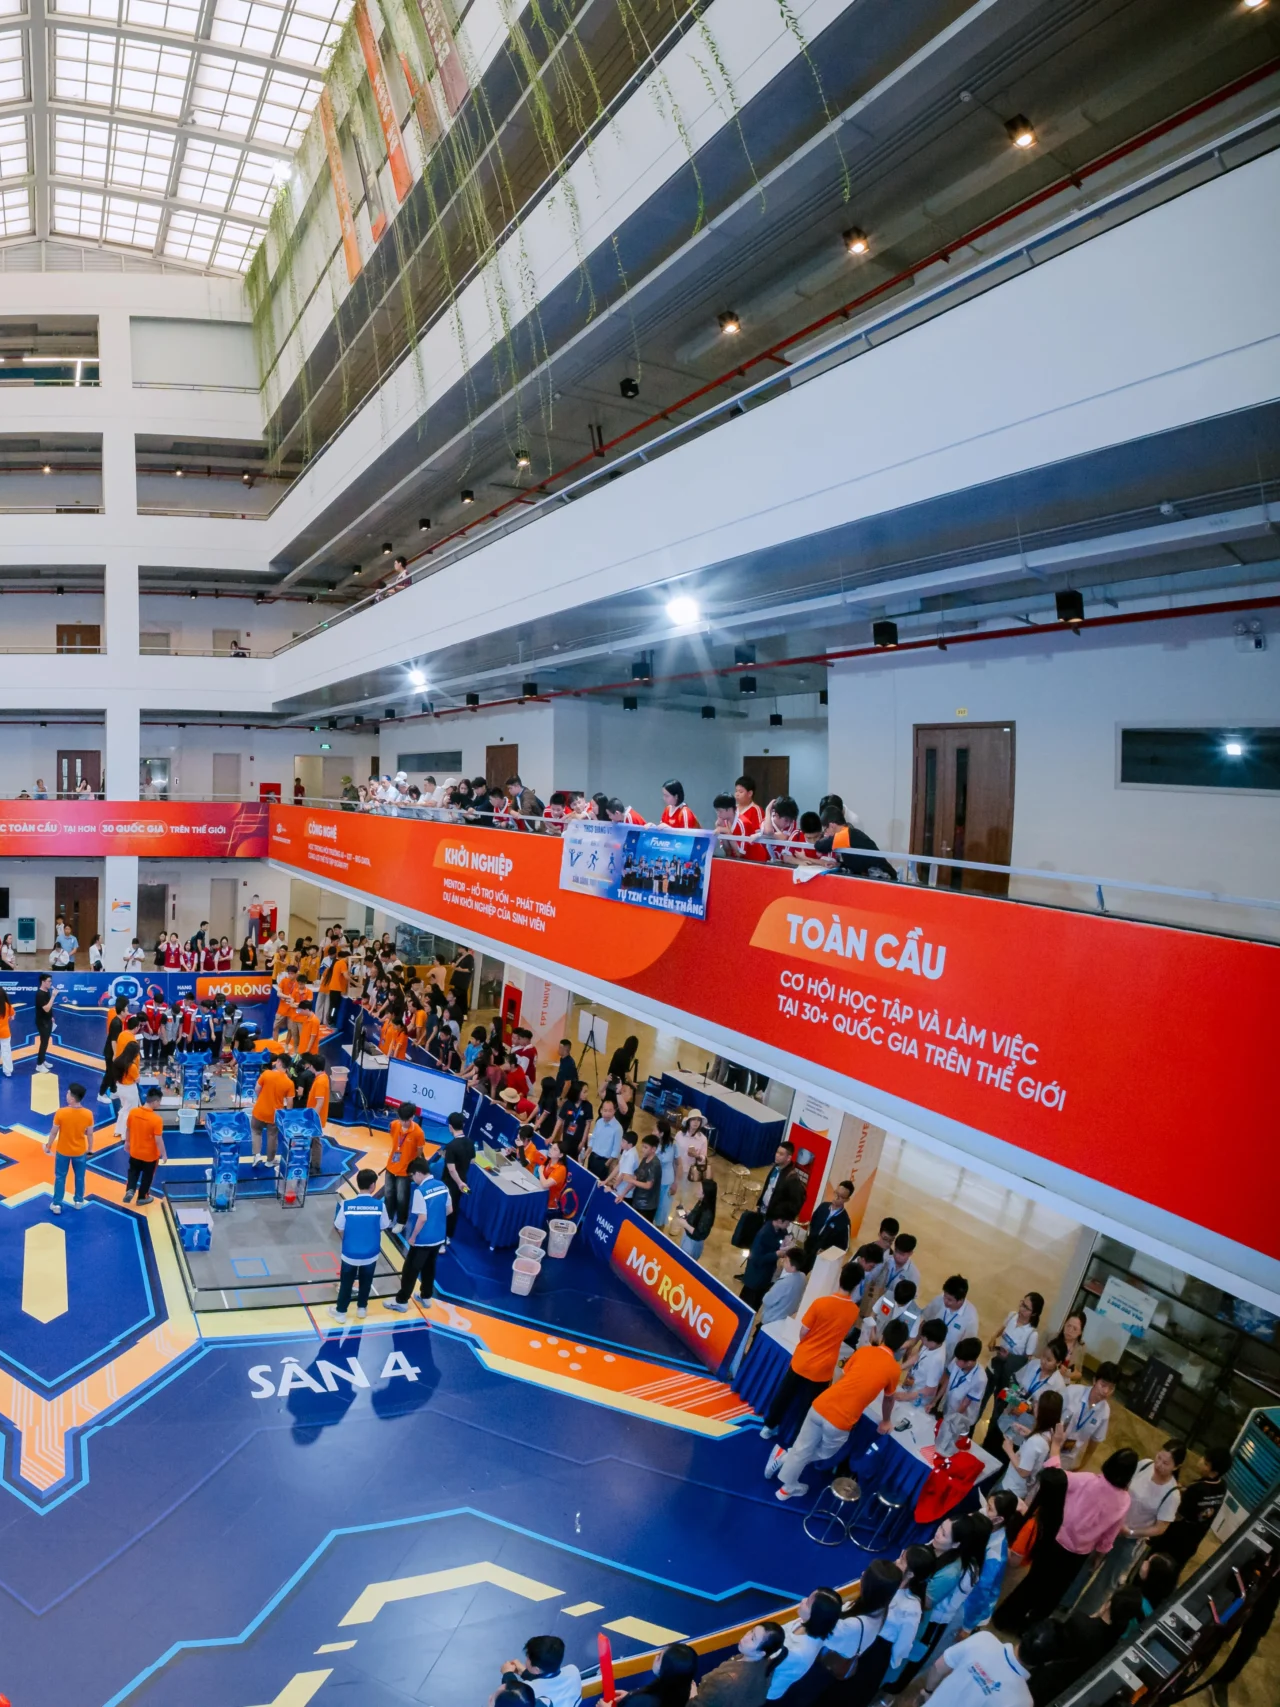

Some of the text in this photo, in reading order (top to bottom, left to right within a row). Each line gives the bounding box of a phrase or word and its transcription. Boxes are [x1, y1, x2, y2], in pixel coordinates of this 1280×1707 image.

[8, 821, 36, 833] TOÀN
[37, 821, 58, 833] CẦU
[64, 825, 76, 835] TẠI
[78, 824, 97, 833] HƠN
[102, 825, 114, 833] 30
[116, 821, 145, 834] QUỐC
[146, 825, 165, 833] GIA
[170, 823, 190, 834] TRÊN
[191, 822, 207, 834] THẾ
[208, 823, 227, 834] GIỚI
[444, 845, 513, 881] KHỞI NGHIỆP
[442, 891, 545, 932] DỰ ÁN KHỞI NGHIỆP CỦA SINH VIÊN
[443, 878, 466, 892] MENTOR
[471, 882, 481, 896] HỖ
[481, 887, 496, 903] TRỢ
[495, 889, 509, 904] VỐN
[516, 897, 535, 911] PHÁT
[535, 900, 556, 918] TRIỂN
[617, 888, 627, 902] TỰ
[627, 890, 643, 903] TIN
[648, 893, 674, 910] CHIẾN
[675, 897, 704, 916] THẮNG
[786, 913, 946, 980] TOÀN CẦU
[208, 981, 271, 998] MỞ RỘNG
[540, 981, 552, 1026] FPT UNIVE
[780, 970, 1040, 1068] CƠ HỘI HỌC TẬP VÀ LÀM VIỆC
[776, 993, 1066, 1112] TẠI 30+ QUỐC GIA TRÊN THẾ GIỚI
[594, 1226, 609, 1244] MỤC
[596, 1213, 615, 1235] HẠNG
[626, 1246, 714, 1339] MỞ RỘNG
[247, 1351, 421, 1399] SÂN 4
